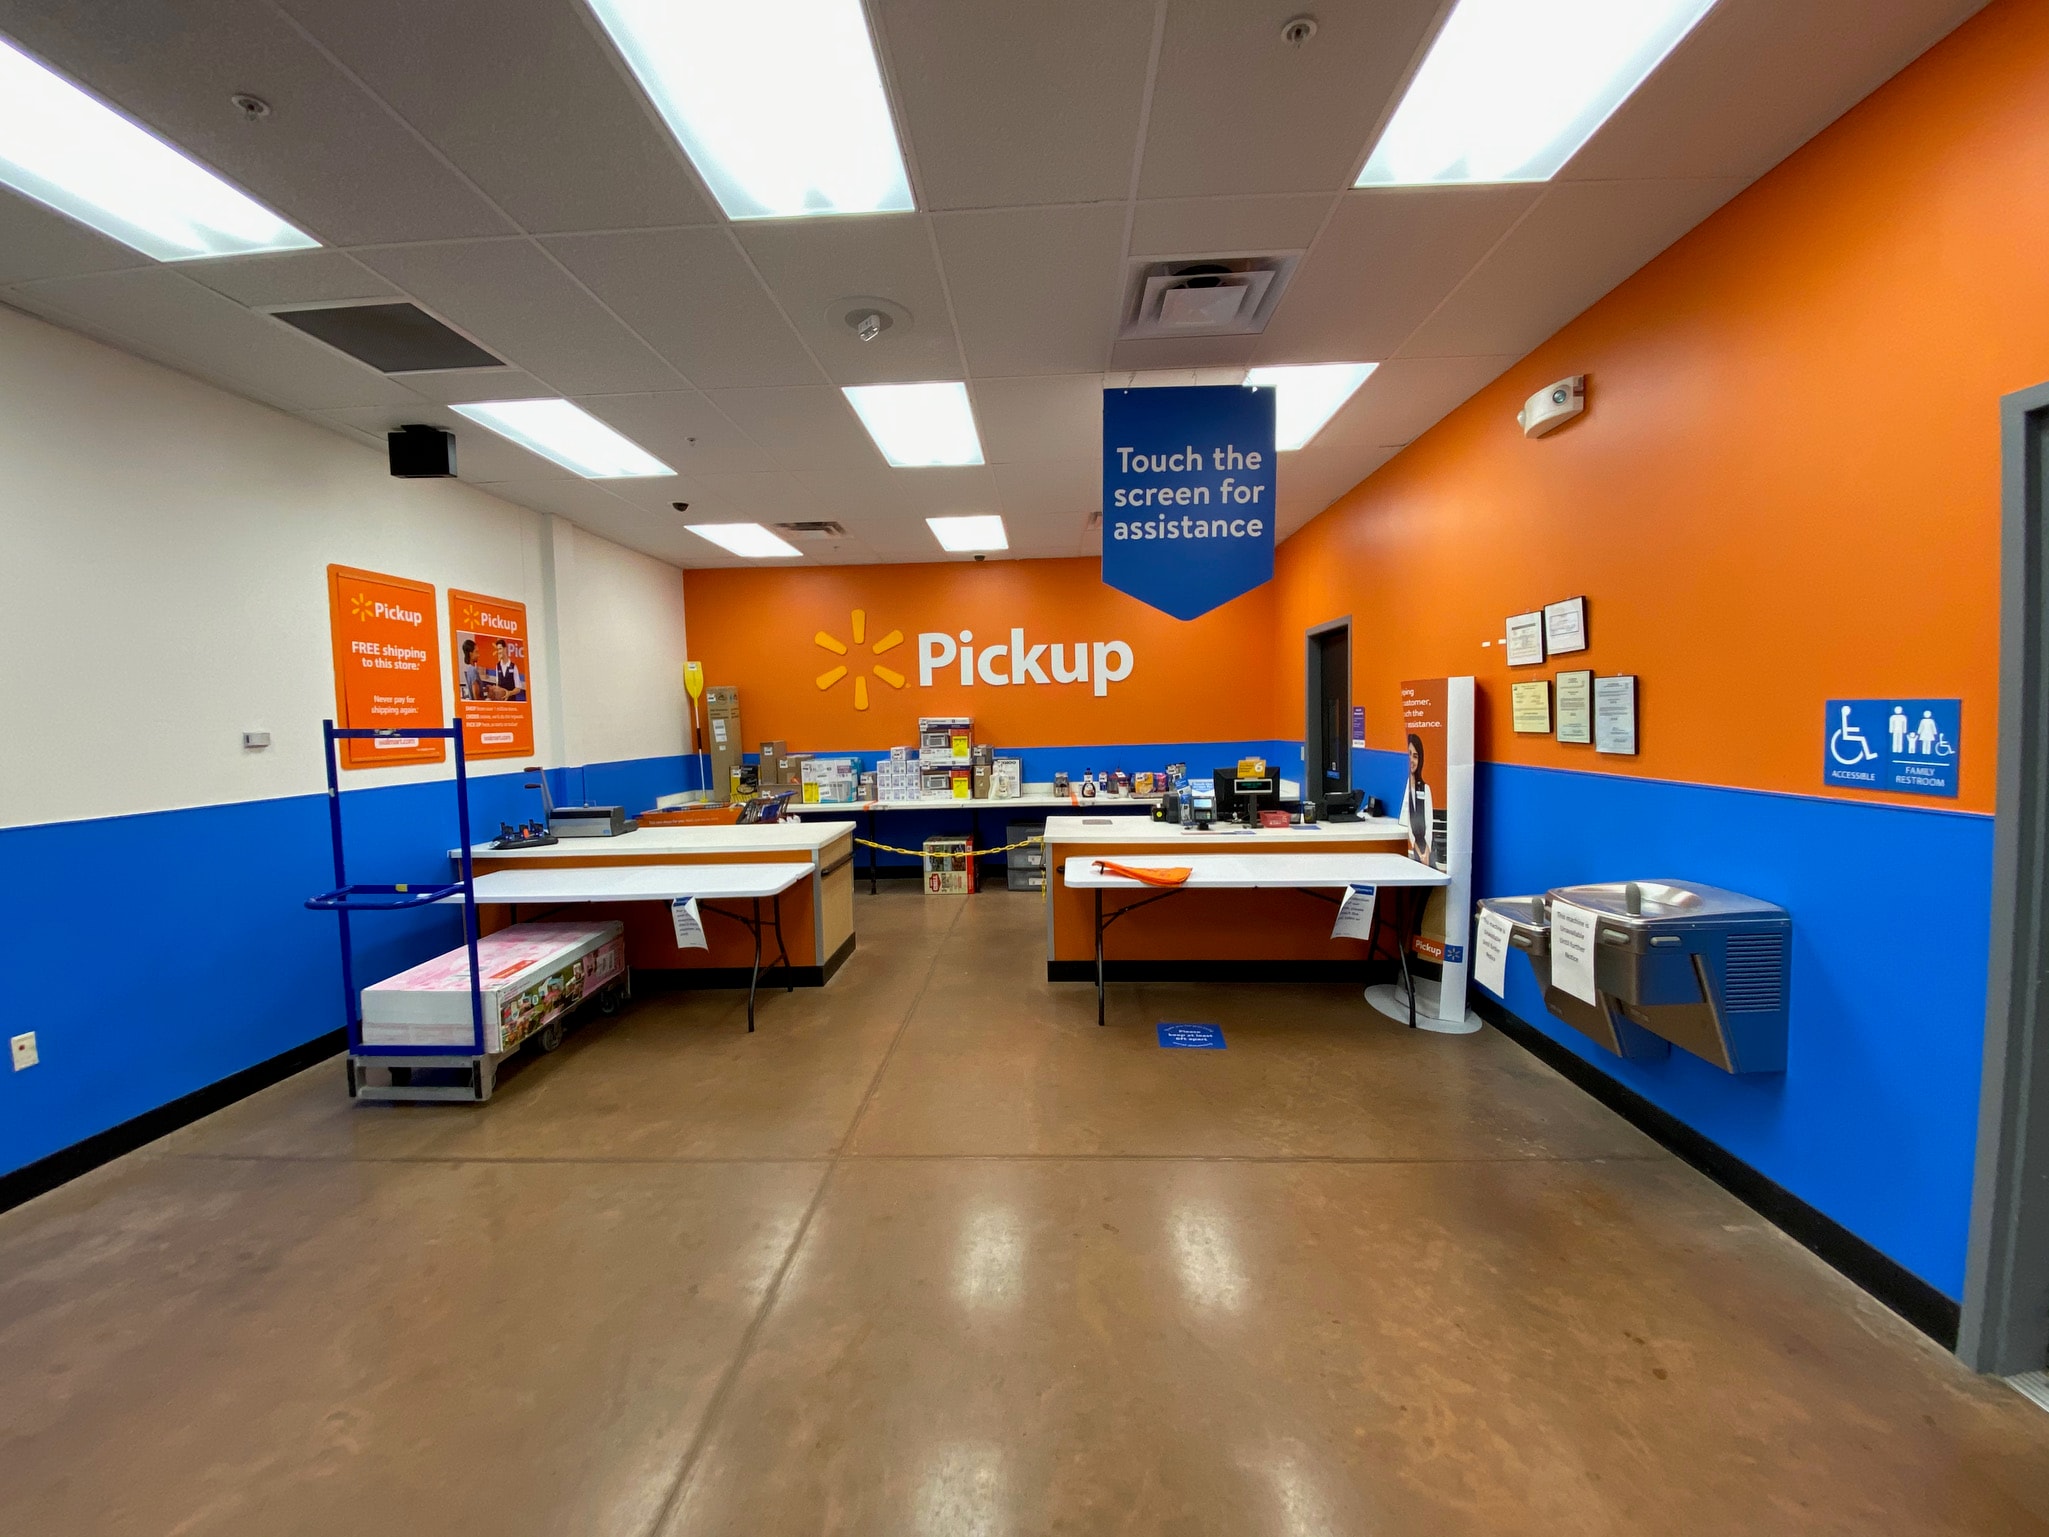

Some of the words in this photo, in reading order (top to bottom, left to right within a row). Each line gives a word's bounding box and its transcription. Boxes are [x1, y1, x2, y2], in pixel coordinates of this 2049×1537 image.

[1116, 445, 1203, 473] Touch
[1212, 444, 1262, 471] the
[1113, 486, 1210, 507] screen
[1220, 478, 1265, 504] for
[1113, 513, 1264, 540] assistance
[374, 602, 423, 627] Pickup
[480, 612, 518, 634] Pickup
[351, 641, 381, 656] FREE
[382, 644, 427, 662] shipping
[362, 658, 373, 668] to
[374, 658, 393, 670] this
[918, 627, 1135, 697] Pickup
[1412, 709, 1424, 717] the
[1254, 762, 1264, 773] 6
[1831, 770, 1876, 782] ACCESSIBLE
[1905, 766, 1936, 776] FAMILY
[1895, 775, 1945, 787] RESTROOM
[1415, 939, 1442, 957] Pickup
